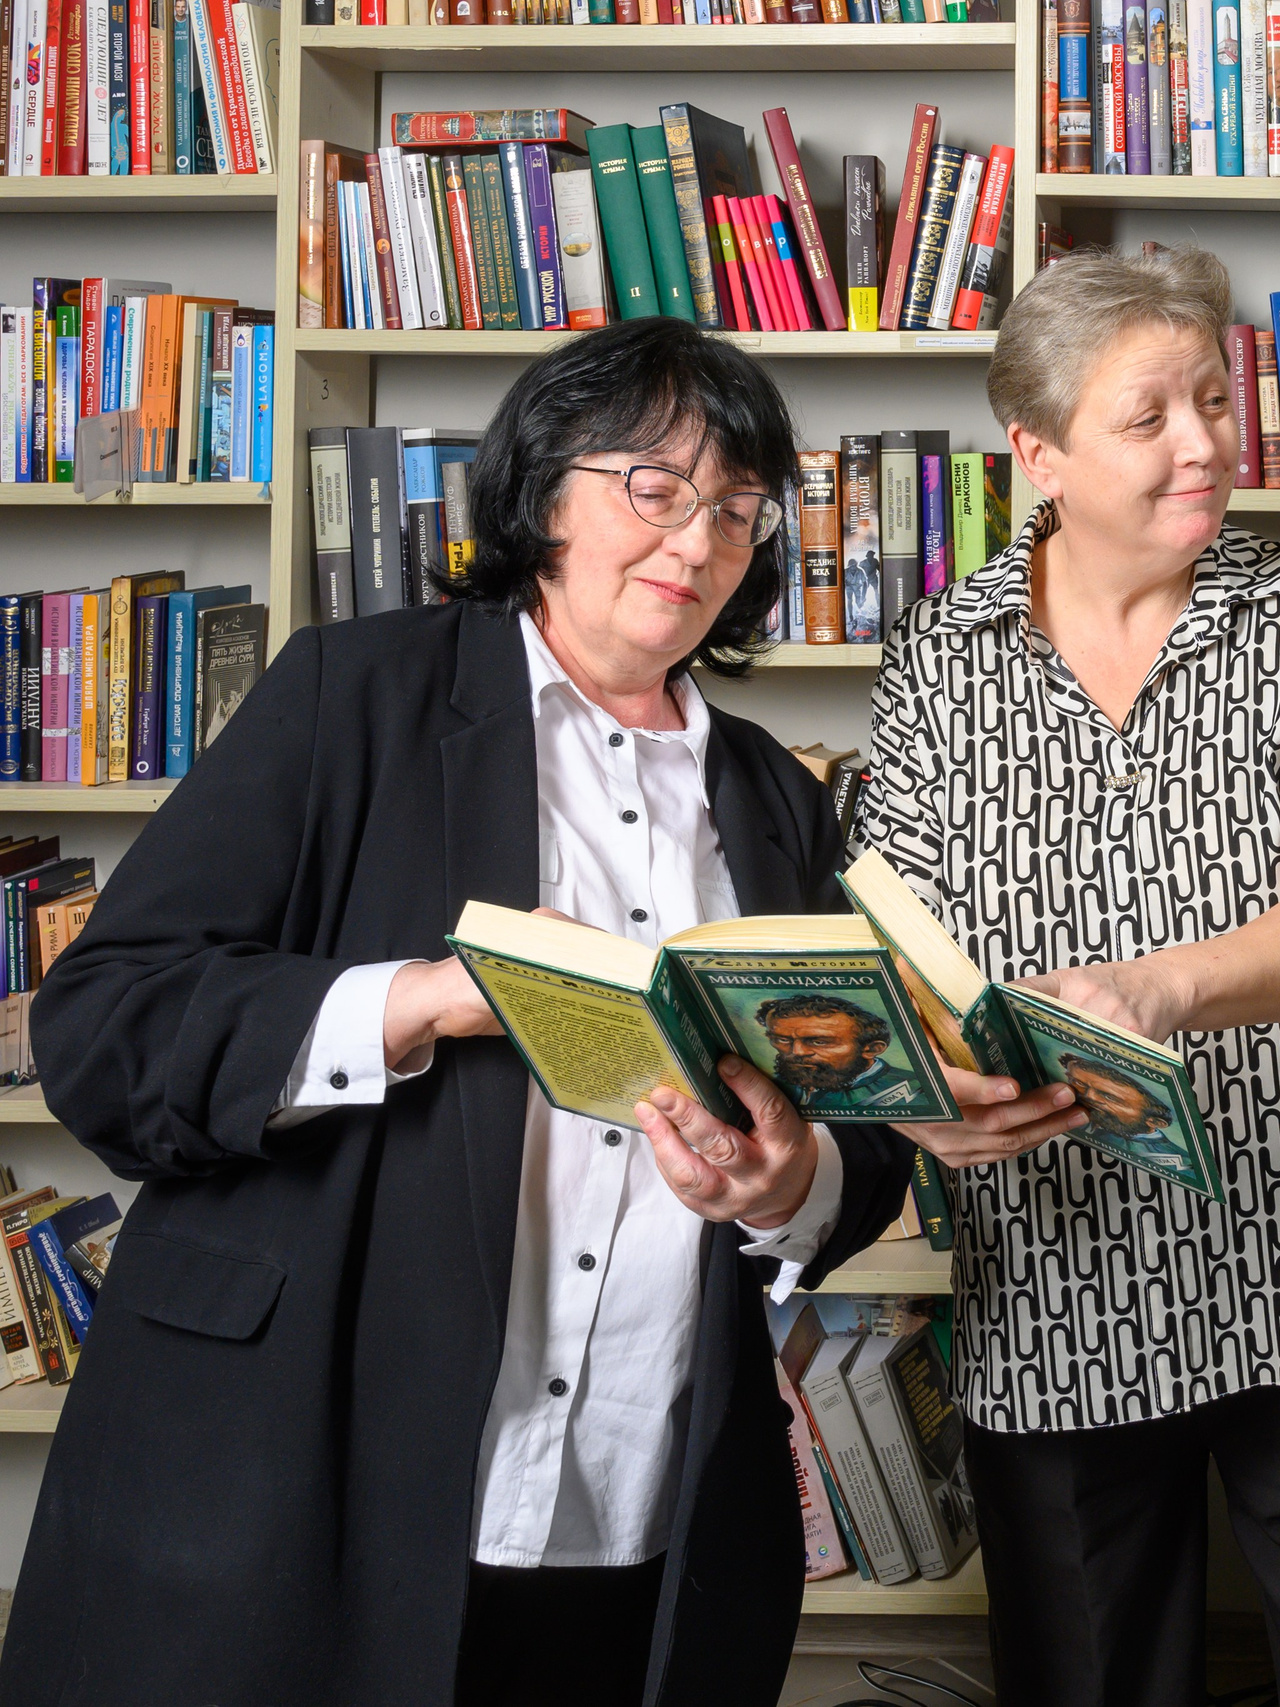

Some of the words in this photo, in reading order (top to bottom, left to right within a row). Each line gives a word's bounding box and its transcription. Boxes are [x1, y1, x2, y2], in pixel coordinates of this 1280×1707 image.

[66, 43, 81, 75] СПОК
[97, 7, 108, 88] СЛЕДУЮЩИЕ
[113, 33, 124, 61] ВТОРОЙ
[227, 45, 241, 83] звездами
[240, 41, 250, 56] ЭТО
[1255, 31, 1264, 72] МОСКВА
[113, 62, 123, 83] МОЗГ
[200, 43, 216, 100] ФИЗИОЛОГИЯ
[218, 37, 238, 117] Краснопольской
[244, 59, 256, 105] НАЧАЛОСЬ
[1113, 46, 1123, 90] МОСКВЫ
[236, 84, 243, 94] со
[1255, 73, 1265, 124] ЧУДЕСНАЯ
[27, 89, 37, 128] СЕРДЦЕ
[63, 77, 79, 147] БЕНДЖАМИН
[97, 101, 107, 124] ЛЕТ
[232, 118, 240, 129] от
[237, 95, 250, 131] главном
[252, 106, 259, 117] НЕ
[1113, 90, 1123, 149] СОВЕТСКОЙ
[211, 108, 225, 156] АНАТОМИЯ
[233, 129, 246, 170] Диагноз
[255, 126, 264, 149] ТЕБЯ
[243, 138, 254, 169] Беседы
[598, 157, 627, 169] ИСТОРИЯ
[602, 165, 626, 175] КРЫМА
[638, 157, 668, 169] ИСТОРИЯ
[642, 165, 667, 175] КРЫМА
[981, 156, 1000, 214] НЕИЗБЕЖНОСТЬ?
[989, 162, 1008, 216] ИСТОРИЧЕСКАЯ
[326, 182, 337, 227] СЛАБЫХ
[327, 229, 337, 258] СИЛА
[473, 219, 484, 265] ОТЕЧЕСТВА
[492, 219, 503, 265] ОТЕЧЕСТВА
[539, 224, 550, 260] ИСТОРИИ
[480, 266, 488, 303] ИСТОРИЯ
[499, 266, 508, 303] ИСТОРИЯ
[538, 270, 555, 303] РУССКОЙ
[630, 286, 641, 298] II
[33, 309, 45, 329] РАЯ
[544, 304, 557, 323] МИР
[33, 332, 46, 380] ИЛЛЮЗИЯ
[85, 320, 96, 384] ПАРАДОКС
[126, 307, 136, 368] Современные
[1235, 337, 1245, 375] МОСКВУ
[258, 352, 268, 401] LAGOM
[34, 387, 45, 413] Шпаков
[1237, 385, 1248, 452] ВОЗВРАЩЕНИЕ
[33, 415, 48, 450] Александр
[848, 464, 858, 501] МИРОВАЯ
[859, 476, 870, 521] ВТОРАЯ
[954, 463, 962, 497] ПЕСНИ
[962, 462, 973, 516] ДРАКОНОВ
[446, 486, 454, 535] ФАТЛАНД
[812, 567, 830, 576] ВЕКА
[51, 606, 59, 636] ИСТОРИЯ
[175, 611, 184, 652] МЕДИЦИНА
[84, 625, 94, 677] ИМПЕРАТОРА
[84, 679, 94, 709] ШЛЯПА
[174, 655, 182, 702] СПОРТИВНАЯ
[28, 666, 40, 730] АНГЛИИ
[50, 693, 58, 725] ИМПЕРИИ
[110, 678, 127, 741] ЗАПИСКИ
[173, 704, 182, 737] ДЕТСКАЯ
[48, 912, 57, 925] II
[708, 974, 875, 989] МИКЕЛАНДЖЕЛО
[1023, 1014, 1165, 1083] МИКЕЛАНДЖЕЛО
[863, 1108, 912, 1117] СТОУН
